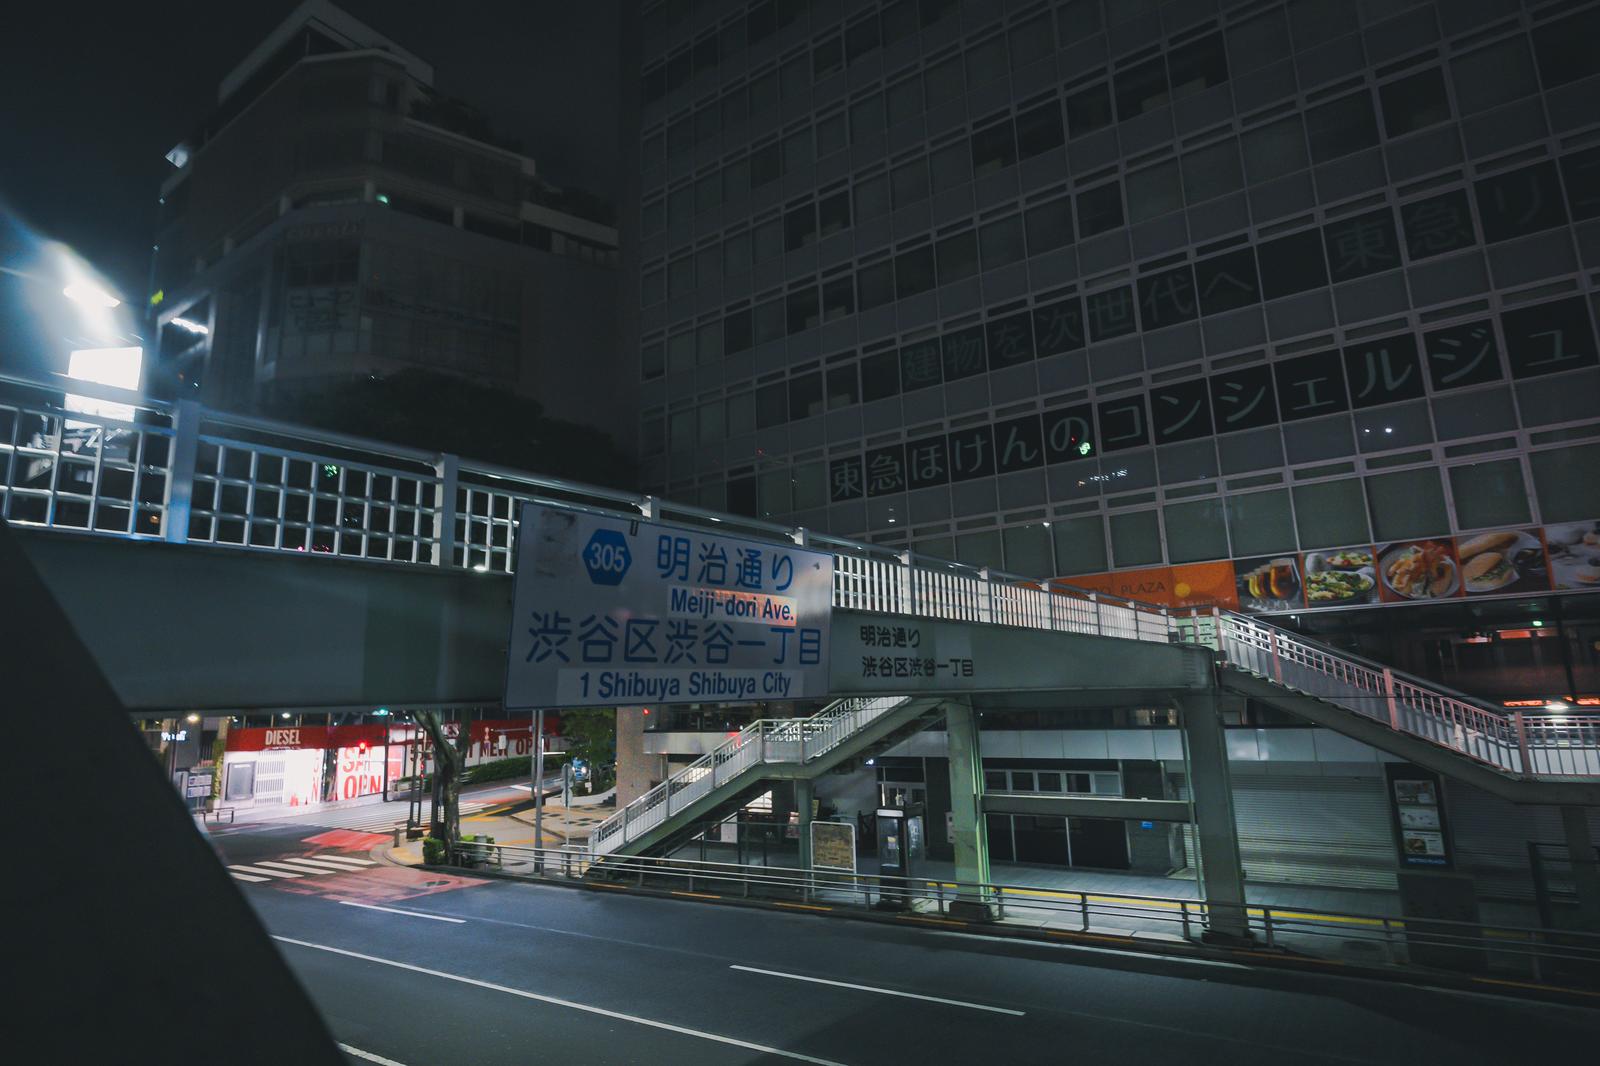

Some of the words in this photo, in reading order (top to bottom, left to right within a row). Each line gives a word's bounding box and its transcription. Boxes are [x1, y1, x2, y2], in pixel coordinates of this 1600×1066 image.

[904, 271, 1254, 387] 建物を次世代へ
[831, 328, 1581, 497] 東急ほけんのコンシェルジュ
[589, 543, 626, 573] 305
[657, 535, 794, 591] 明治通り
[1119, 581, 1167, 596] PLAZA
[671, 588, 757, 619] Meiji-dori
[762, 597, 795, 620] Ave.
[526, 610, 821, 665] 渋谷区渋谷一丁目
[860, 625, 920, 648] 明治通り
[862, 656, 974, 677] 渋谷区渋谷一丁目
[579, 674, 590, 697] 1
[598, 671, 680, 701] Shibuya
[689, 672, 756, 699] Shibuya
[763, 671, 792, 697] City
[264, 729, 302, 746] DIESEL
